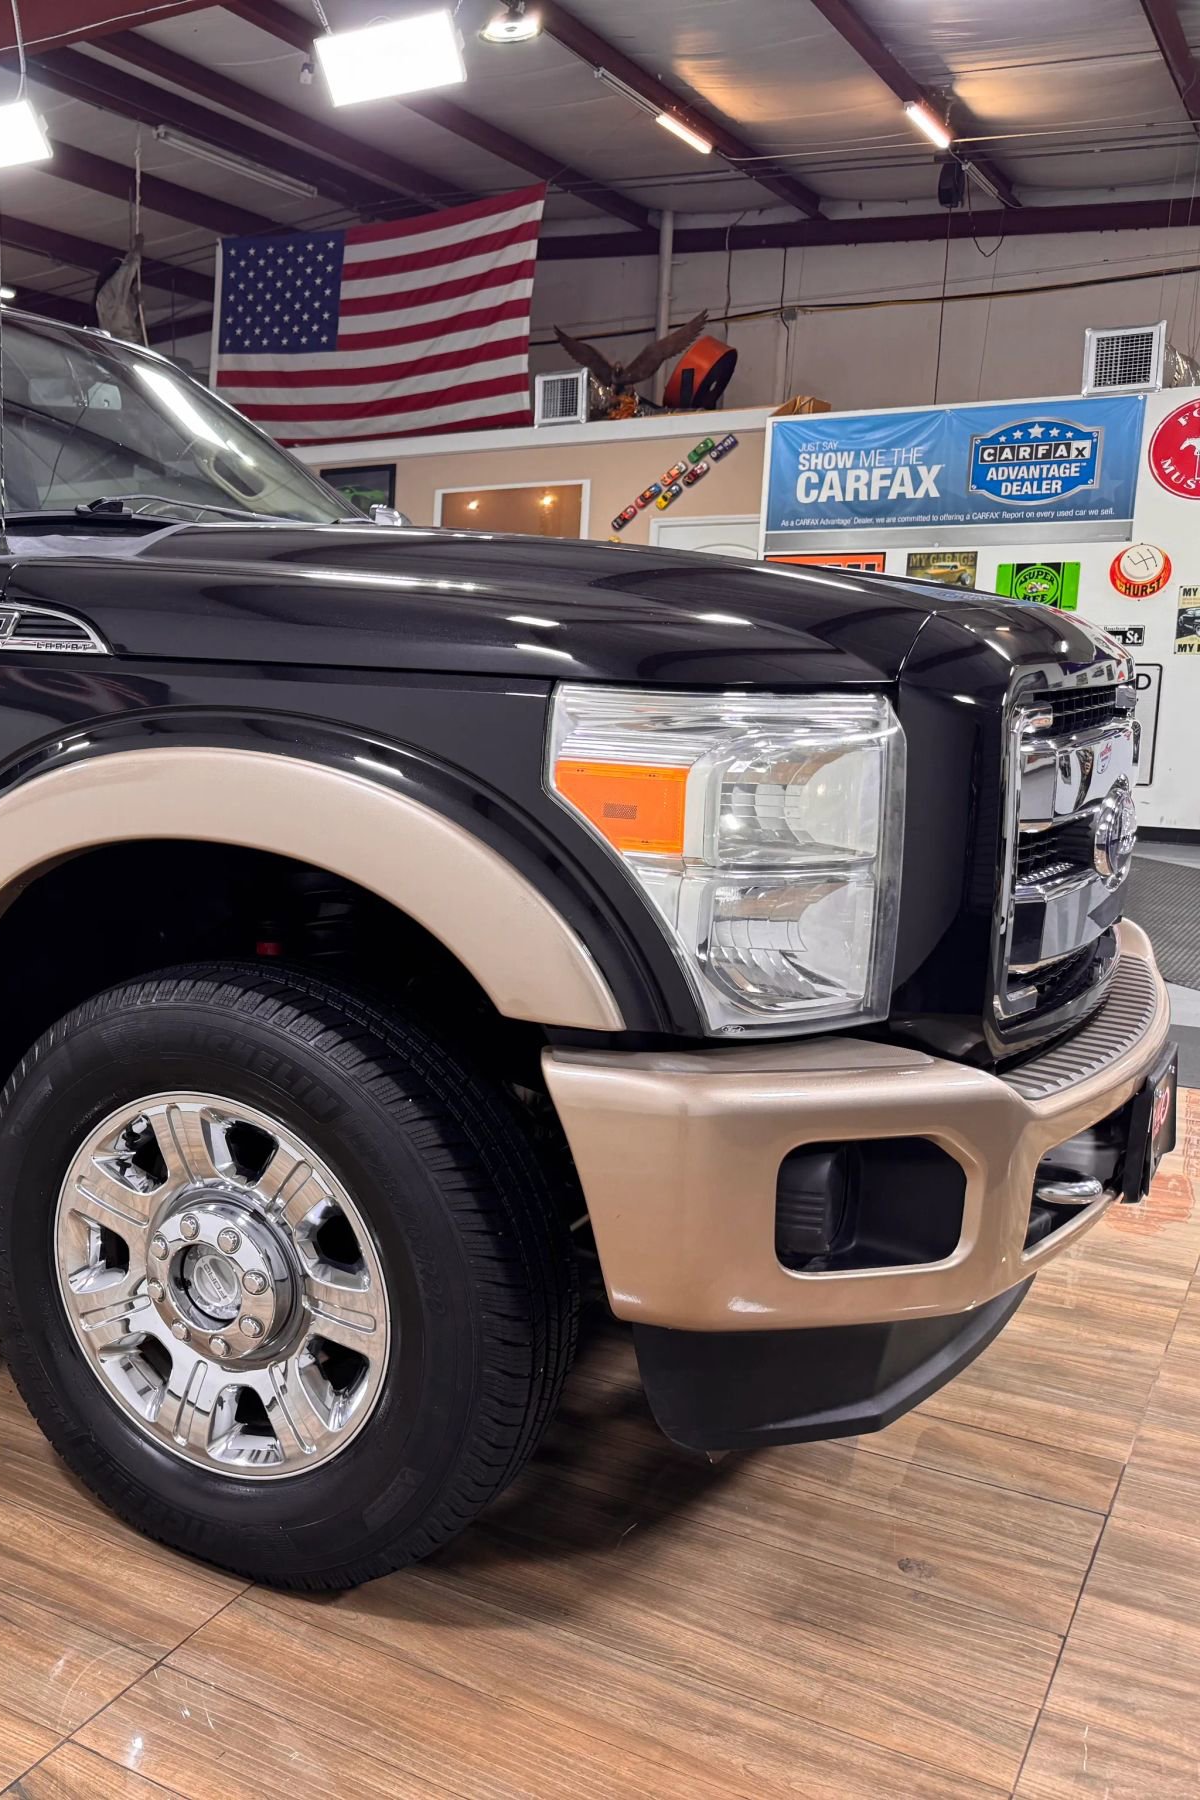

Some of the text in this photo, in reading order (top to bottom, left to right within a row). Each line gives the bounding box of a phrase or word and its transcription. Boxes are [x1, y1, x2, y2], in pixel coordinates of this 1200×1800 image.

[798, 440, 839, 452] JUST SAY
[983, 443, 1088, 461] CARFAX
[798, 447, 923, 470] SHOW ME THE
[796, 464, 942, 504] CARFAX
[1001, 480, 1062, 496] DEALER
[781, 519, 789, 527] As
[795, 518, 819, 526] CARFAX
[897, 513, 931, 523] committed
[939, 512, 964, 522] offering
[1002, 510, 1025, 519] Report
[1036, 510, 1055, 518] every
[1056, 509, 1074, 517] used
[909, 552, 976, 567] MY GARAGE
[1019, 570, 1056, 586] SUPER
[1124, 576, 1162, 597] HURST
[1182, 588, 1199, 597] MY
[1125, 630, 1142, 644] St.
[36, 642, 89, 651] LARIAT
[1177, 644, 1195, 653] MY
[170, 1028, 351, 1119] ICHELIN
[203, 1262, 228, 1300] FORD
